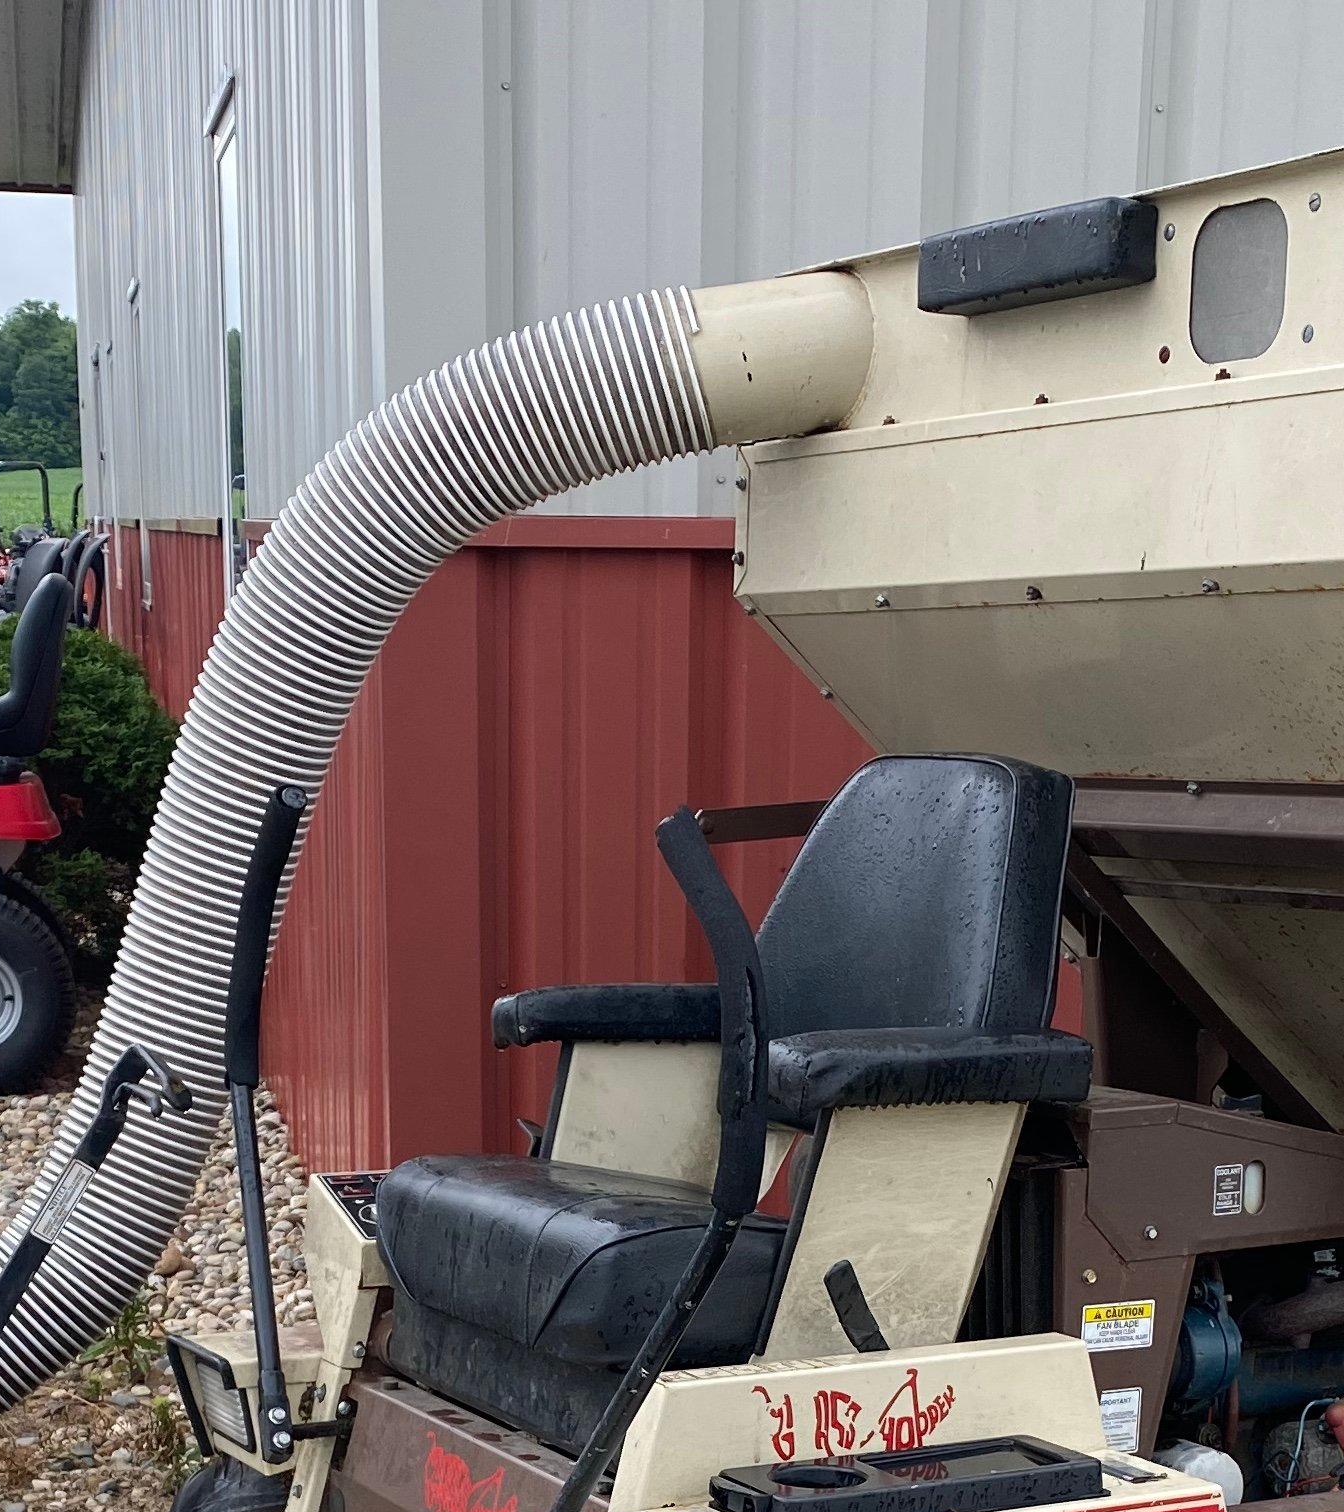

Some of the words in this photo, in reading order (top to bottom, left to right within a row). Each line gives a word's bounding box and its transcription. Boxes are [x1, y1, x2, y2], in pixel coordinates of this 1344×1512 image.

[1105, 1307, 1145, 1319] CAUTION
[1096, 1322, 1112, 1330] FAN
[1113, 1320, 1139, 1329] BLADE
